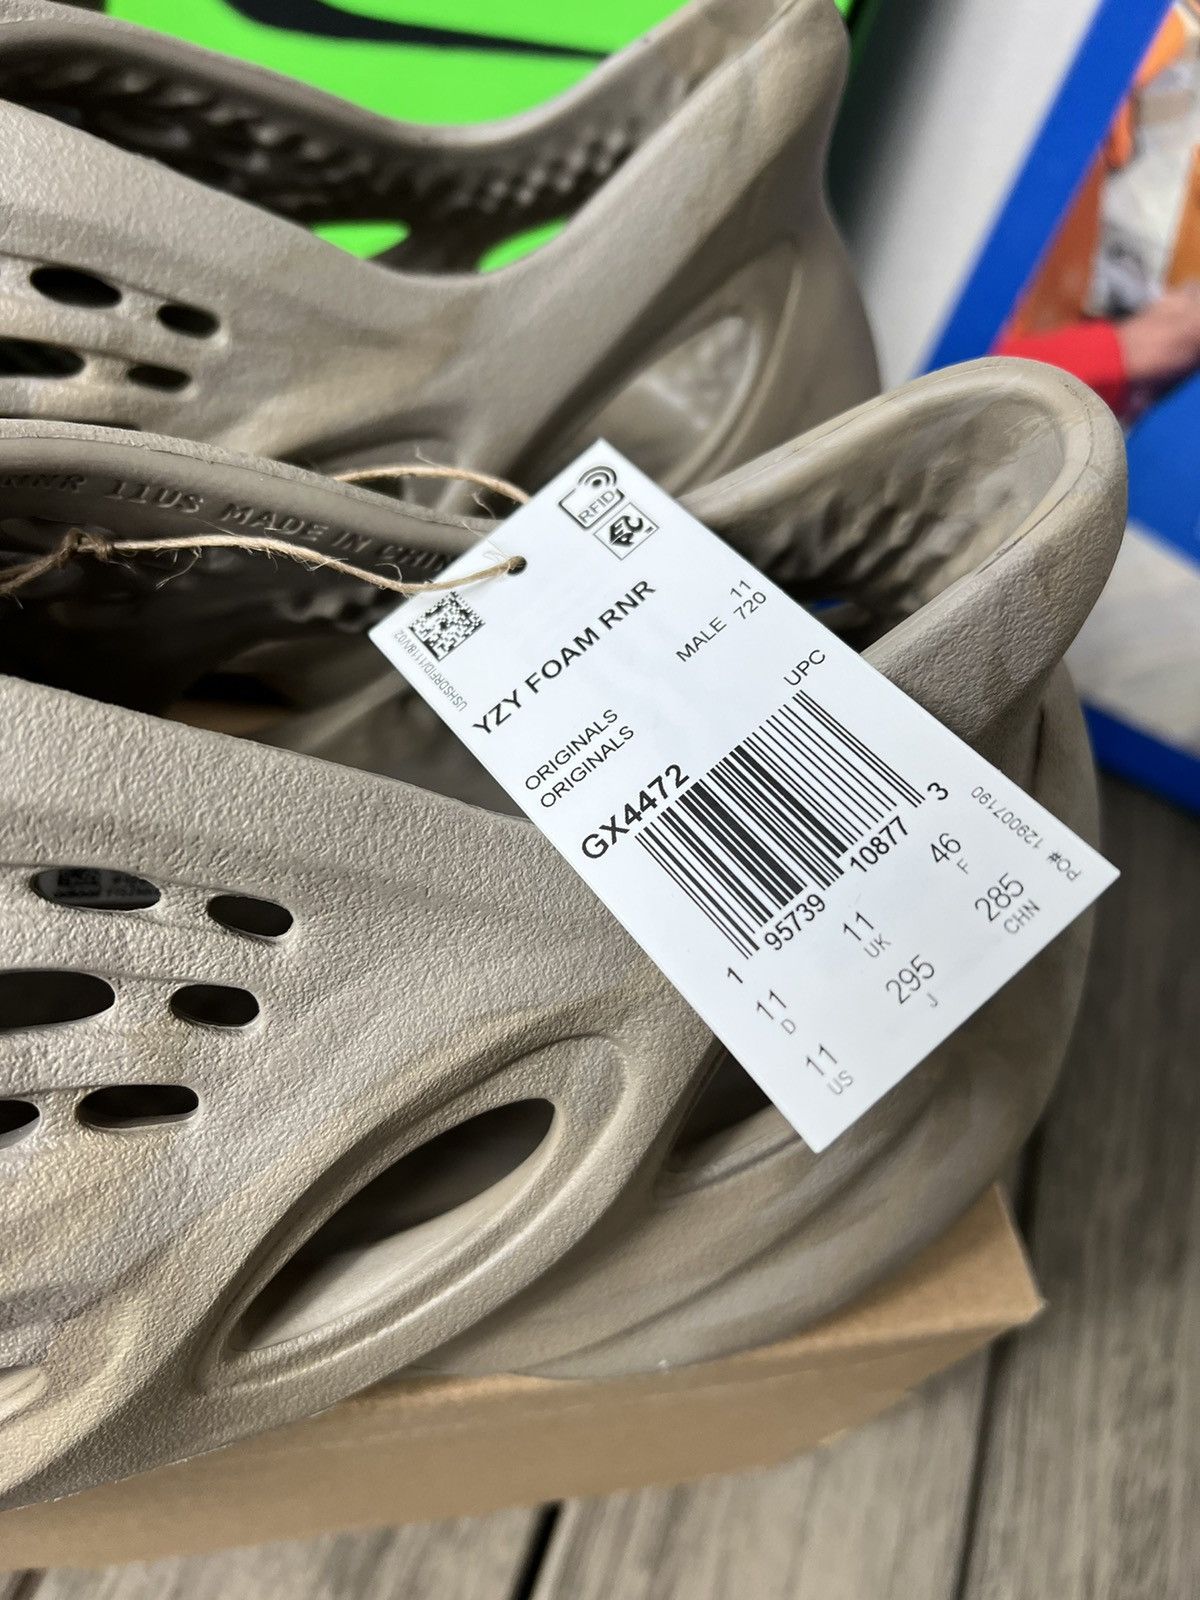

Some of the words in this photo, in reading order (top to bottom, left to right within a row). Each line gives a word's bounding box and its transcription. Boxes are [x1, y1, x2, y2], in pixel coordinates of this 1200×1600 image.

[578, 490, 615, 524] RFID
[221, 503, 329, 542] MADE
[332, 532, 372, 553] IN
[730, 579, 752, 600] 11
[675, 616, 728, 663] MALE
[734, 591, 768, 620] 720
[473, 690, 523, 735] YZY
[525, 626, 601, 695] FOAM
[598, 579, 657, 632] RNR
[783, 649, 827, 687] UPC
[525, 708, 618, 791] ORIGINALS
[540, 725, 634, 808] ORIGINALS
[580, 763, 690, 860] GX4472
[971, 786, 1044, 851] 129007190
[929, 832, 962, 864] 46
[957, 859, 970, 875] F
[1047, 852, 1082, 882] PO#
[727, 967, 744, 985] 1
[764, 893, 827, 951] 95739
[850, 816, 908, 873] 10877
[927, 782, 949, 801] 3
[974, 872, 1024, 922] 285
[843, 911, 875, 942] 11
[1003, 898, 1041, 936] CHN
[863, 935, 892, 958] UK
[886, 954, 936, 1005] 295
[756, 989, 788, 1021] 11
[780, 1018, 797, 1035] D
[805, 1043, 838, 1077] 11
[826, 1070, 854, 1096] US
